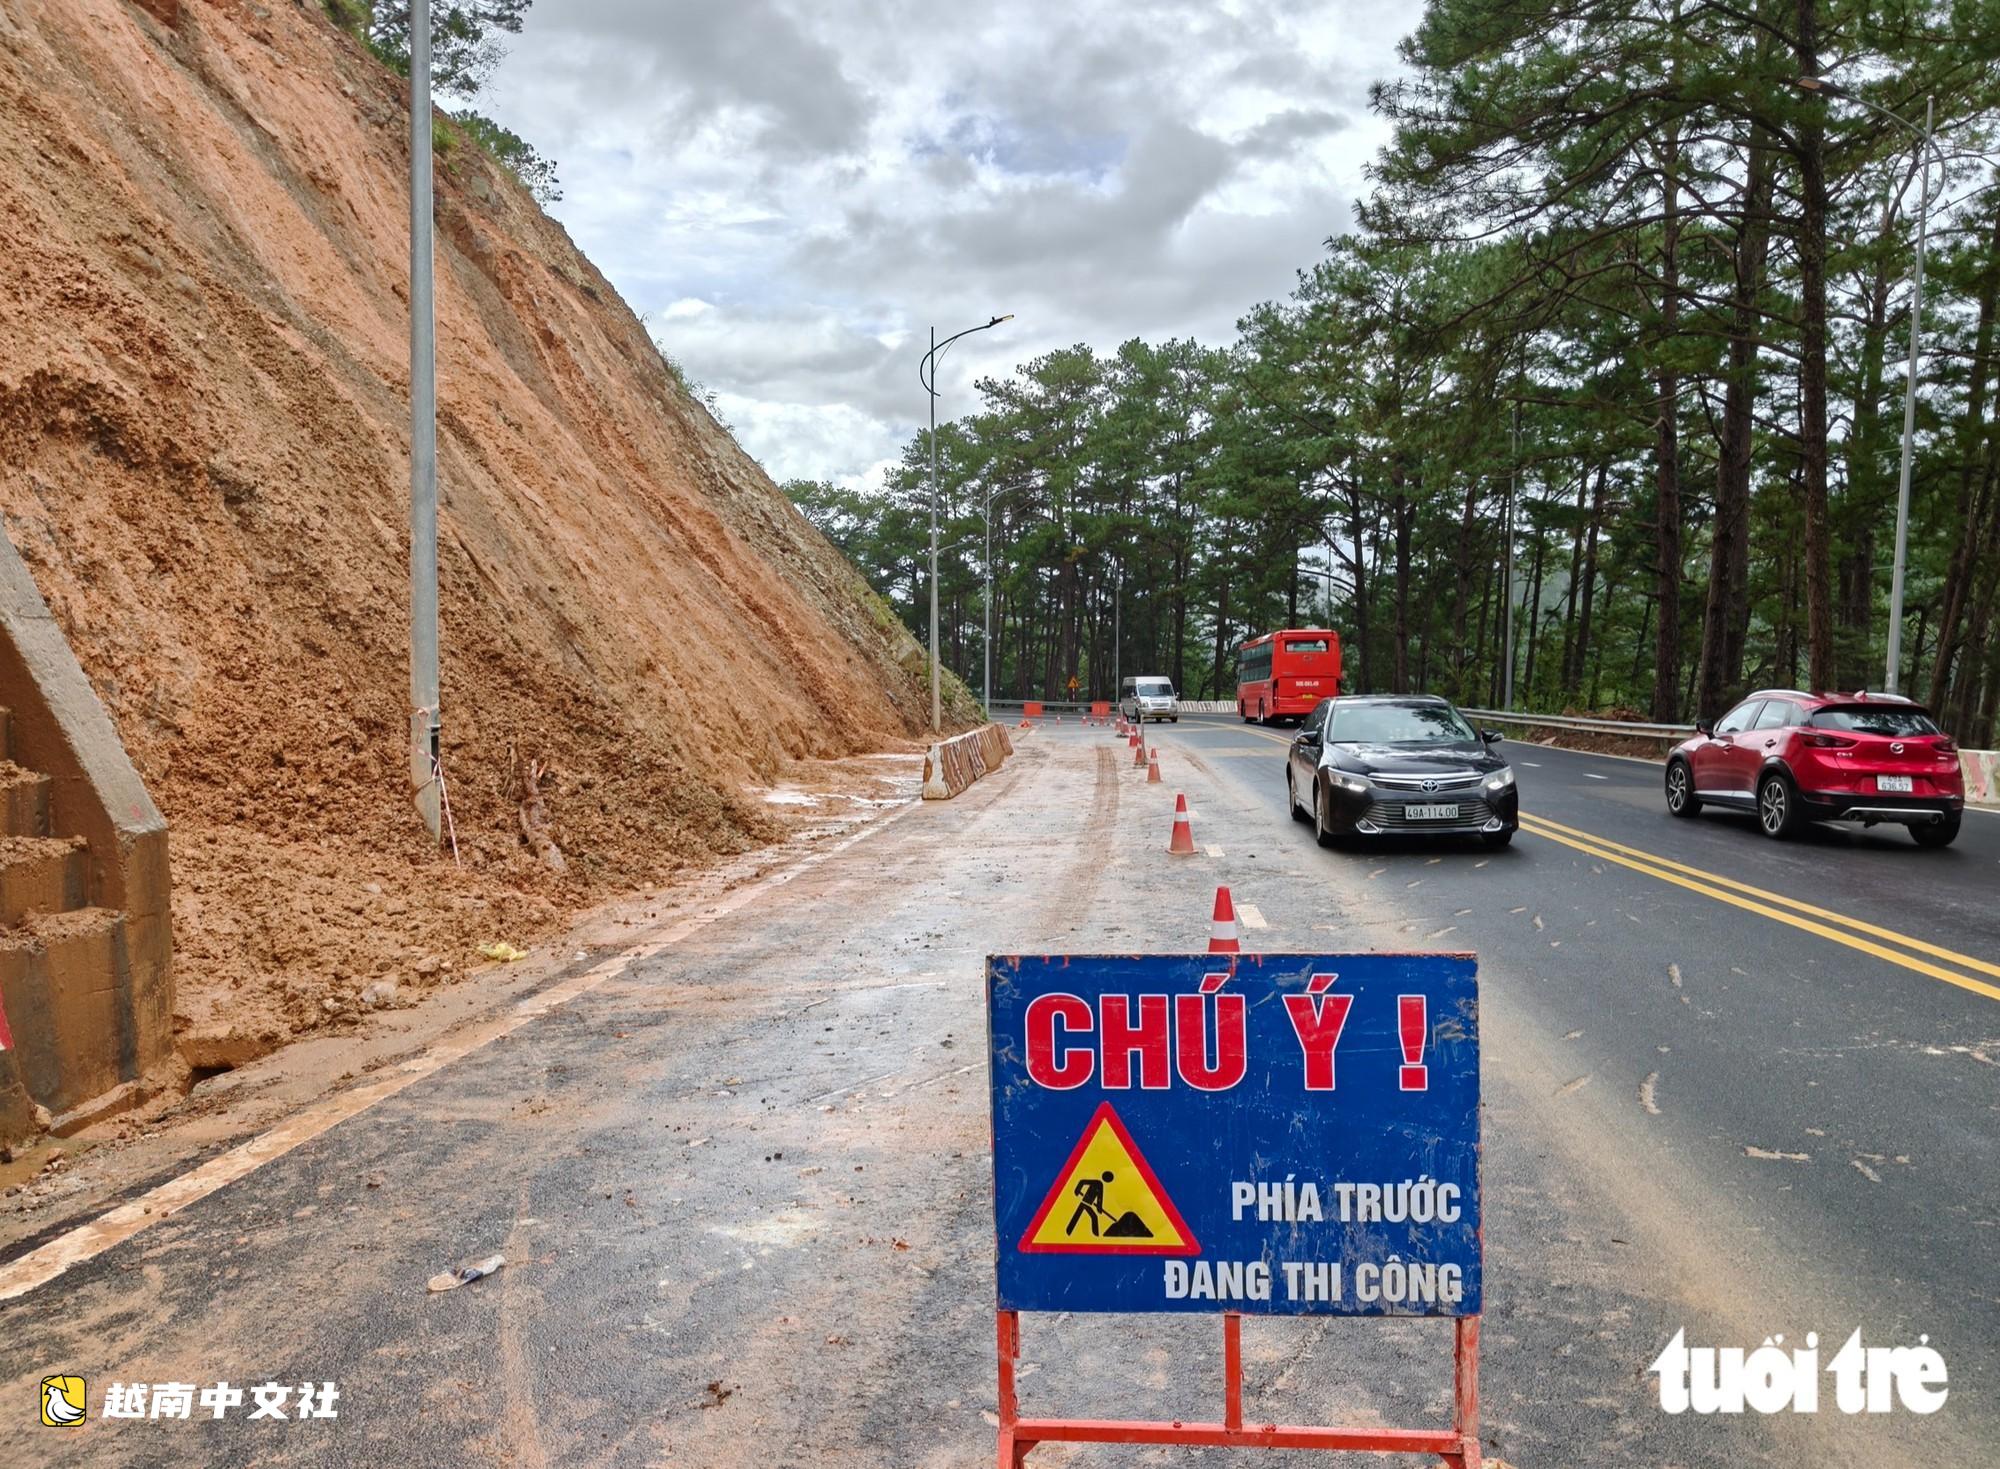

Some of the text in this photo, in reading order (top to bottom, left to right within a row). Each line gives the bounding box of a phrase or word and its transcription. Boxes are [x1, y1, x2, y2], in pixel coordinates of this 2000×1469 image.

[1025, 972, 1429, 1091] CHÚ Ý !
[1231, 1173, 1462, 1223] PHÍA TRƯỚC
[1163, 1255, 1463, 1302] ĐANG THI CÔNG
